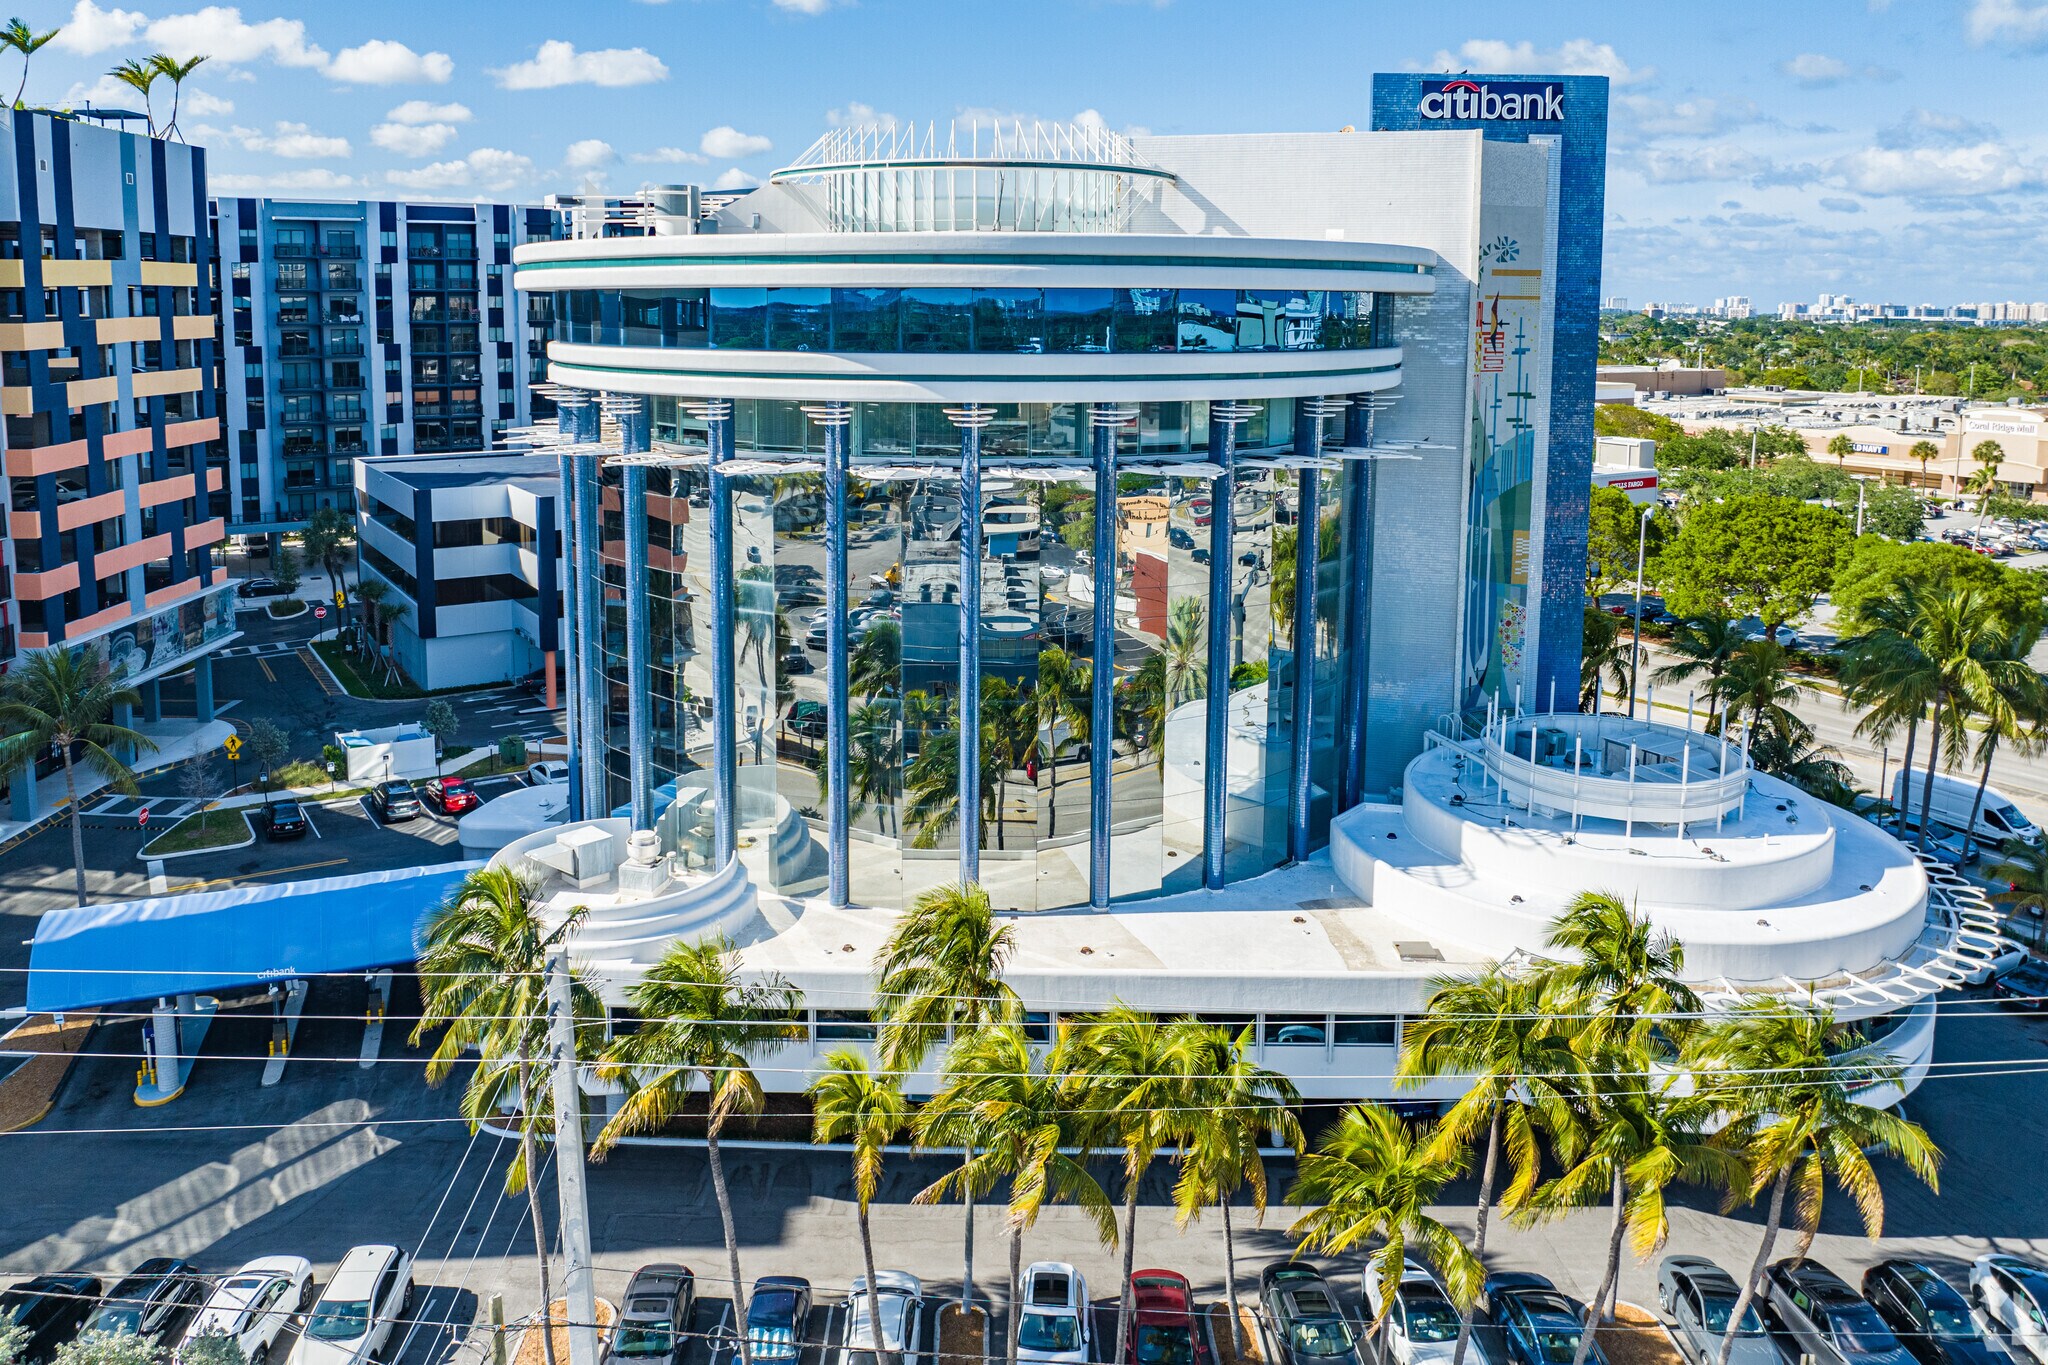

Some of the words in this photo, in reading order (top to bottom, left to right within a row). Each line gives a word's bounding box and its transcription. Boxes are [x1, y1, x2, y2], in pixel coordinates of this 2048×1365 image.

[1420, 82, 1565, 120] citibank
[1969, 421, 1990, 431] Coral
[1992, 422, 2015, 433] Ridge
[2017, 424, 2035, 434] Mall
[1863, 444, 1883, 454] NAVY
[1628, 480, 1644, 488] FARGO
[257, 966, 297, 979] citibank
